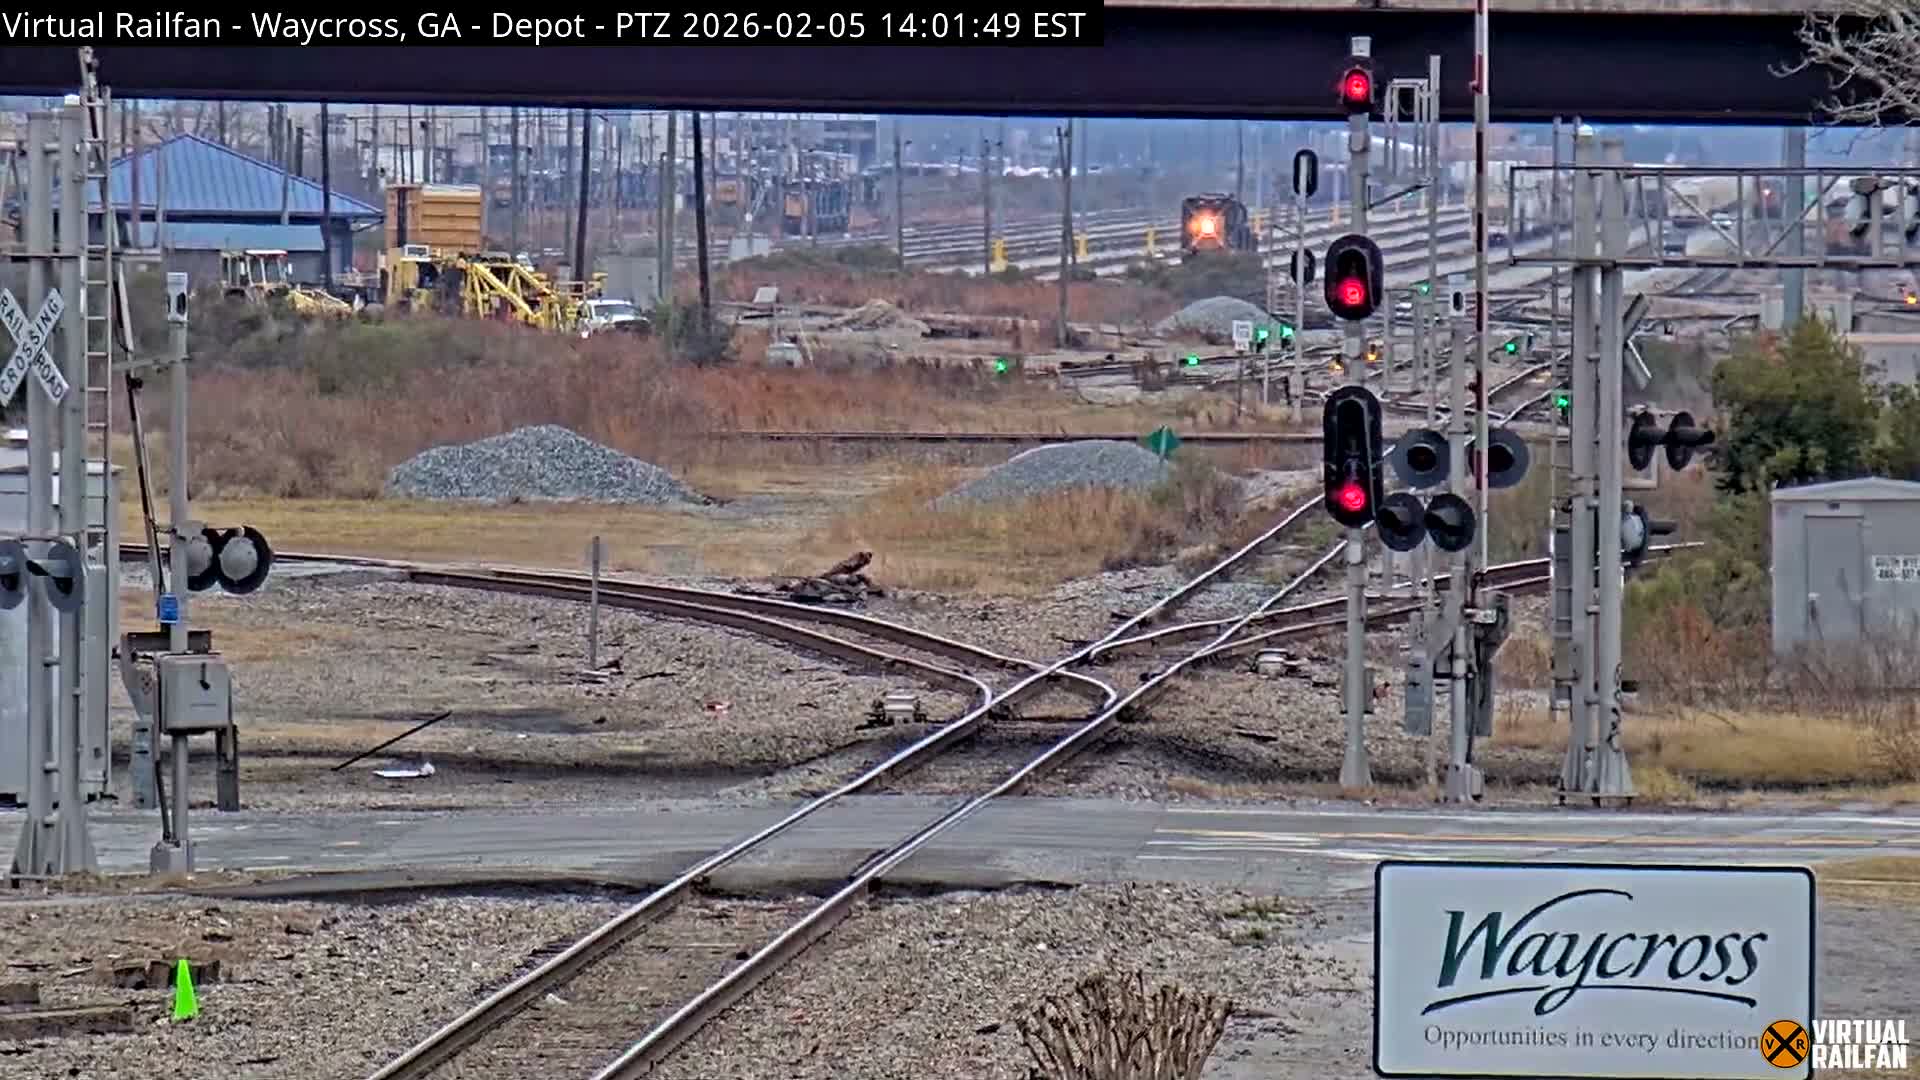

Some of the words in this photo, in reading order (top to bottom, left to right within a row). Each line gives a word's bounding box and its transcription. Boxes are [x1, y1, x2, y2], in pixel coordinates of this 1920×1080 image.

[0, 295, 23, 339] RAIL
[37, 353, 63, 398] ROAD
[1, 298, 59, 394] CROSSING
[1437, 889, 1768, 1015] Waycross
[1424, 1025, 1568, 1050] Opportunities
[1575, 1027, 1594, 1046] in
[1600, 1033, 1660, 1053] every
[1666, 1028, 1760, 1050] direction
